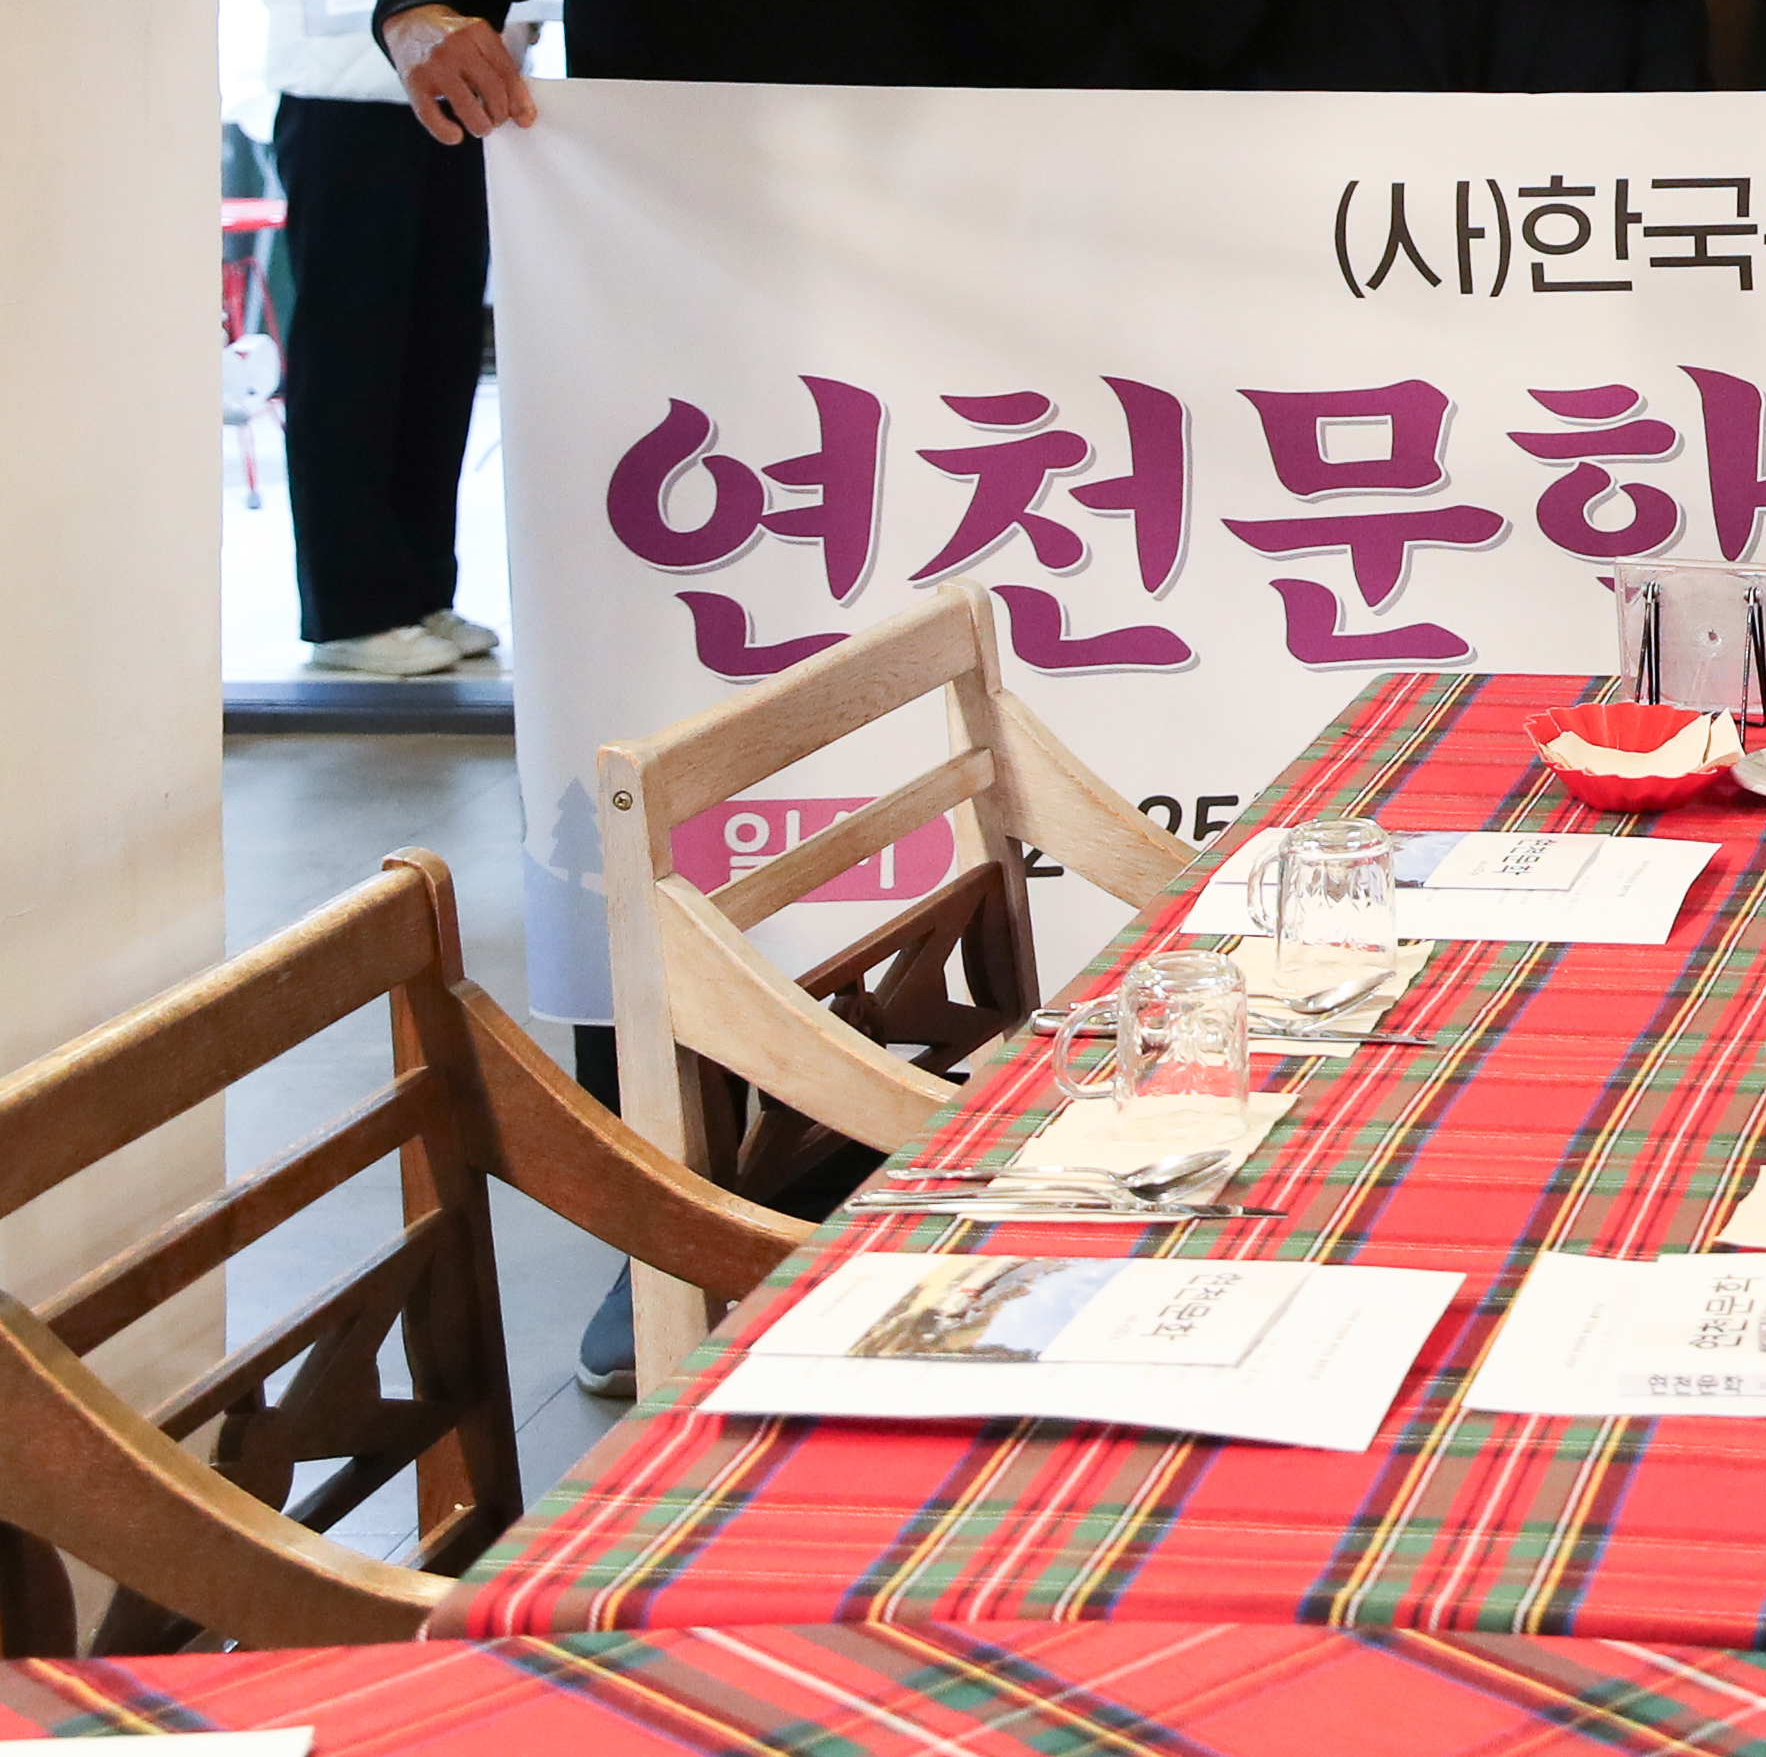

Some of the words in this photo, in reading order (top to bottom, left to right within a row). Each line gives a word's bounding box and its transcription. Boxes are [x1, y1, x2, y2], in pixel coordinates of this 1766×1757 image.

[724, 809, 896, 890] 일
[1138, 1272, 1244, 1340] 연천문학
[1688, 1274, 1761, 1349] 연천문학
